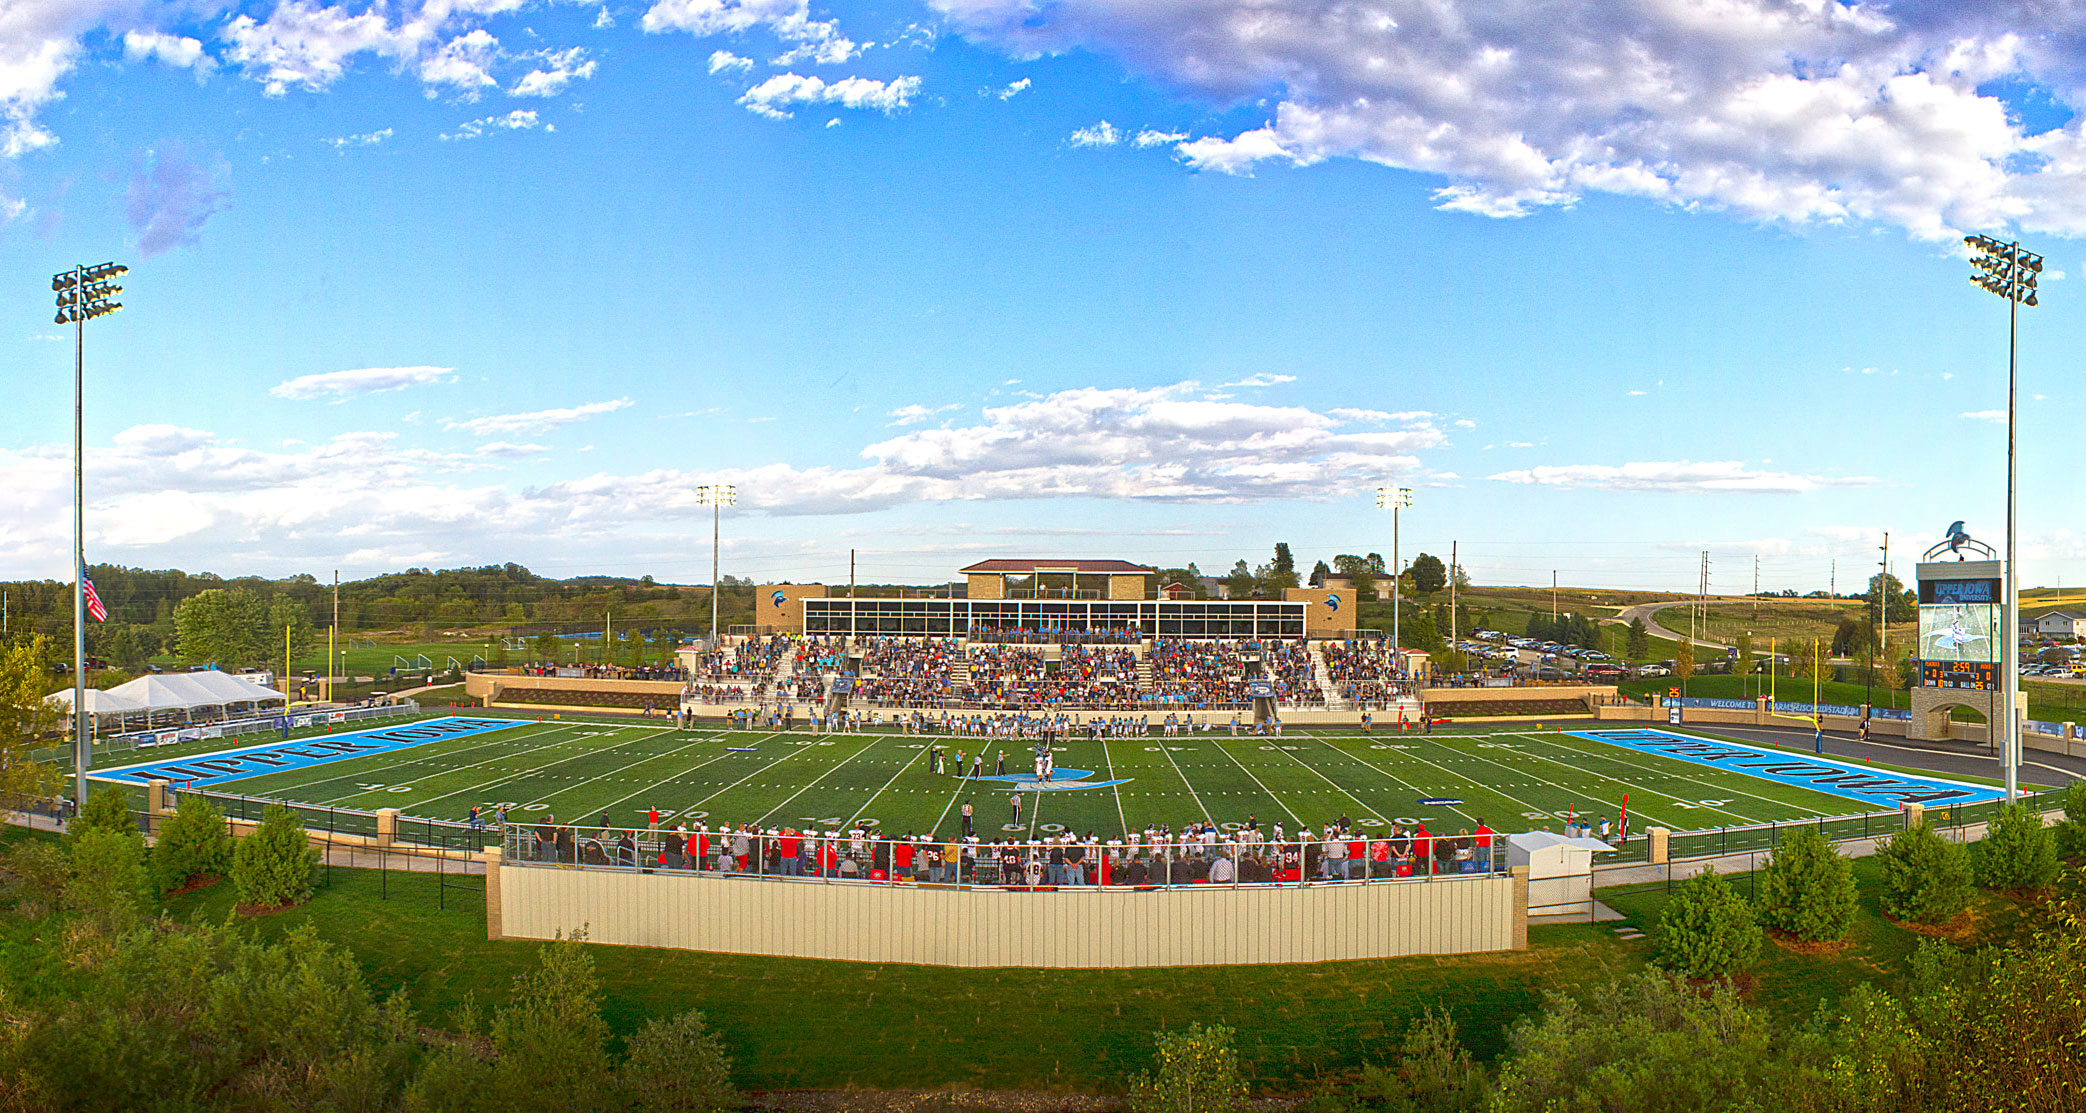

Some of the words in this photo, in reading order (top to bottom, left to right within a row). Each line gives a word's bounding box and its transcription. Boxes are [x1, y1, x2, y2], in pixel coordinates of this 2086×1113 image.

[1936, 583, 1964, 595] UPPER
[1964, 583, 1990, 595] IOWA
[1960, 594, 1990, 602] UNIVERSITY
[1953, 662, 1970, 672] 2:59
[1932, 669, 1937, 678] 0
[1986, 671, 1991, 681] 0
[1976, 681, 1983, 691] 25
[1669, 688, 1680, 698] 25
[1711, 700, 1746, 709] WELCOME
[1828, 705, 1859, 716] STADIUM
[127, 741, 390, 782] UPPER
[361, 719, 514, 744] IOWA
[1585, 731, 1766, 761] UPPER
[1729, 761, 1976, 803] IOWA
[359, 782, 413, 793] 10
[1672, 799, 1725, 809] 10
[1521, 811, 1580, 819] 20
[1357, 817, 1420, 826] 30
[1285, 852, 1298, 863] 94
